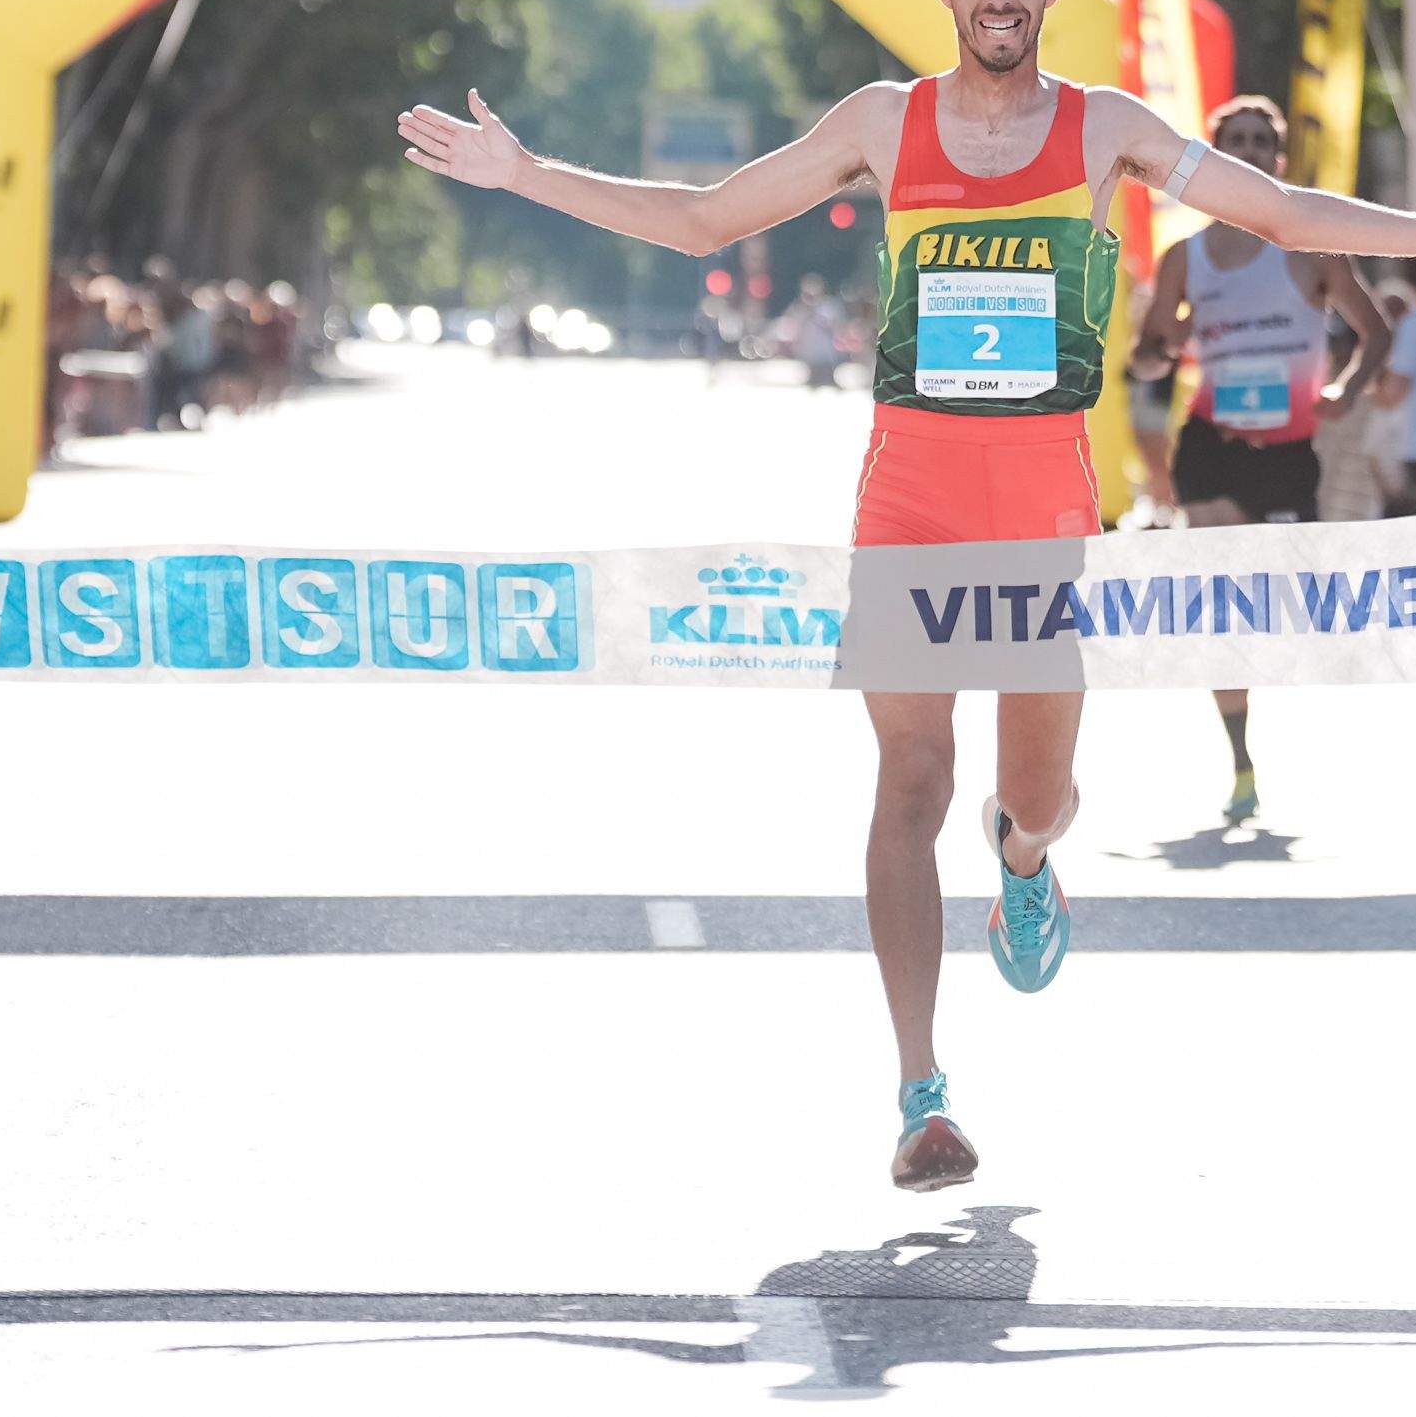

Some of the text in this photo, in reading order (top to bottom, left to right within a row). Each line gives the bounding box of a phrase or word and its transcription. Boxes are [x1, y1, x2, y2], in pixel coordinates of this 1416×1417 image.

[915, 234, 1053, 269] BIKILA
[927, 284, 1047, 294] KLM Royal Dutch Airlines
[927, 297, 1047, 312] NORTE VS SUR
[971, 324, 1001, 360] 2
[923, 385, 942, 393] WELL
[978, 381, 999, 390] BM
[277, 568, 558, 661] SUR
[910, 571, 1271, 644] VITAMIN
[650, 605, 841, 647] KLM
[651, 654, 843, 671] Royal Dutch Airlines
